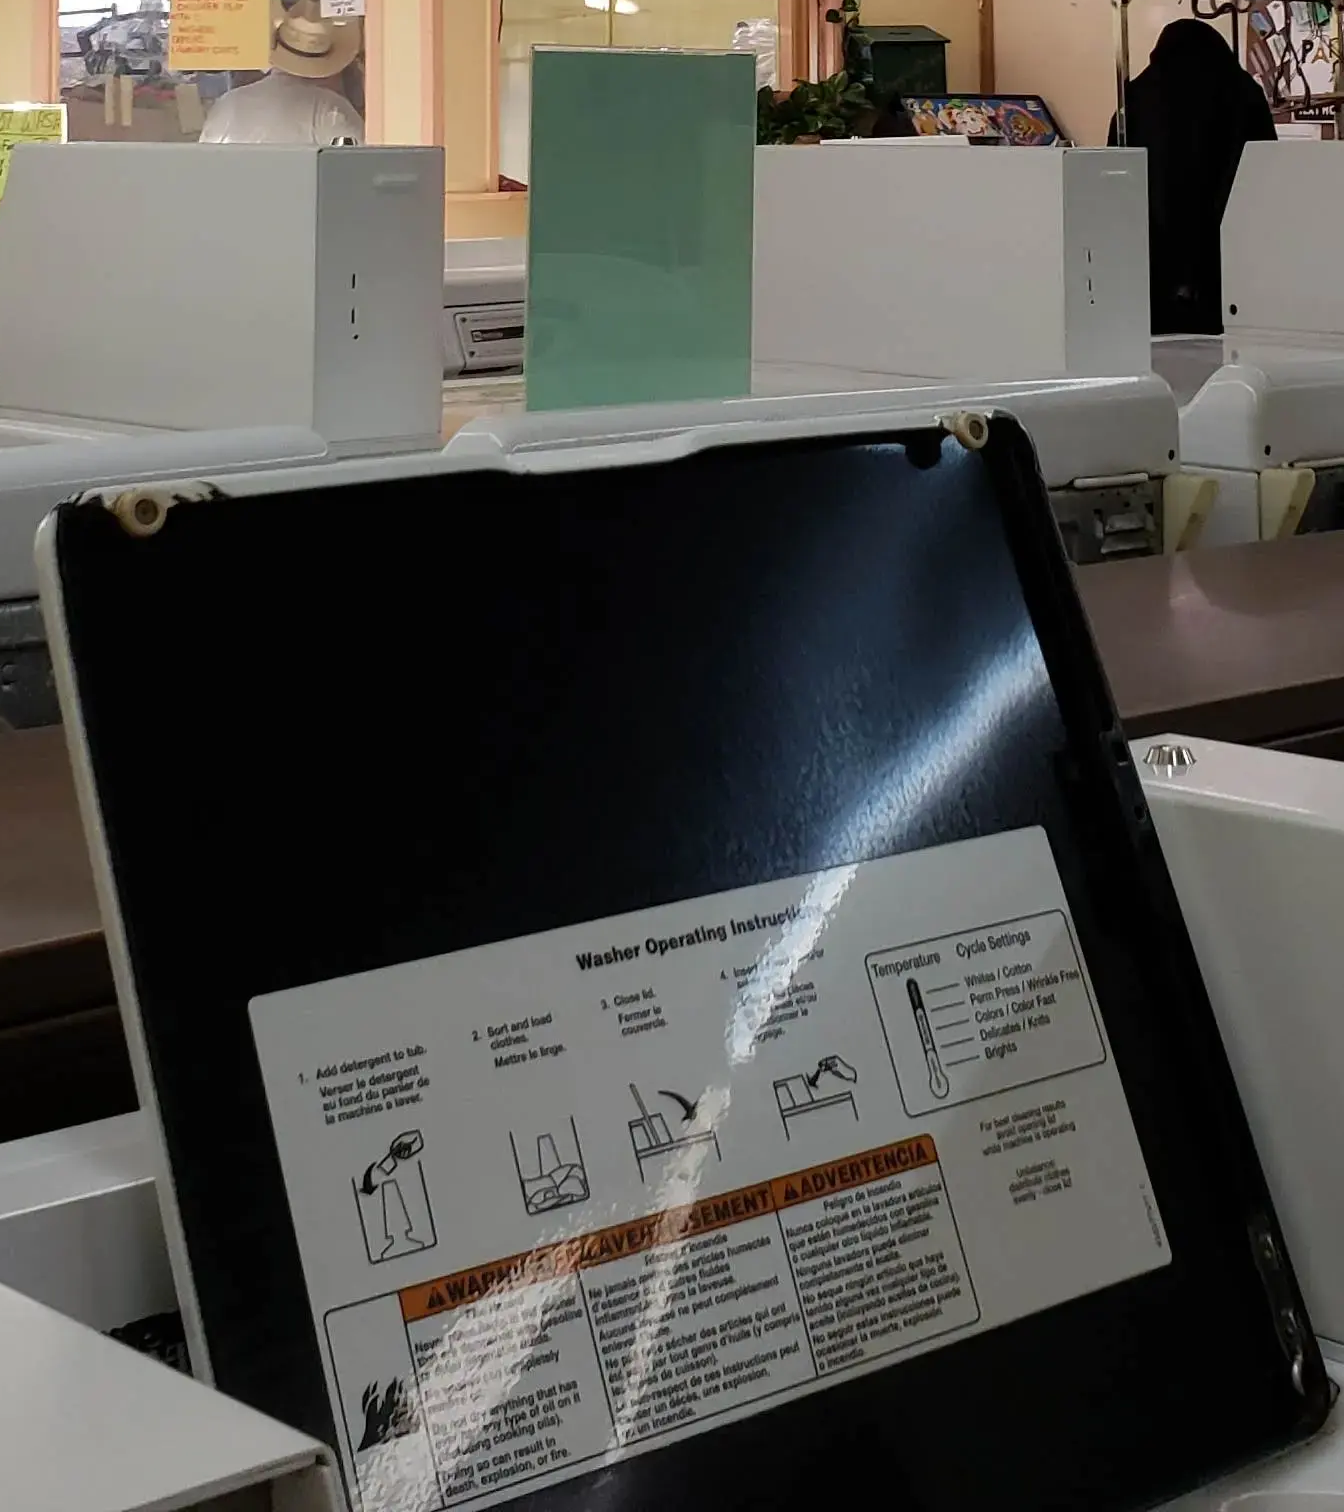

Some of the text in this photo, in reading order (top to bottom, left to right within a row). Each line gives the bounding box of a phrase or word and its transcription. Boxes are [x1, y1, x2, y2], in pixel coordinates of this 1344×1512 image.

[575, 945, 640, 971] Washer
[644, 925, 728, 956] Operating
[870, 930, 1031, 979] Temperature Cycle Settings
[963, 962, 1033, 989] Whites Cotton
[969, 968, 1080, 1007] Perm Press Wrinkle Free
[613, 993, 641, 1007] Close
[641, 987, 656, 1000] lid.
[974, 992, 1057, 1024] Colors Color Fast
[471, 1012, 553, 1043] 2. Sort and load
[617, 1008, 651, 1025] Fermer
[979, 1022, 1022, 1042] Delicates
[489, 1034, 529, 1051] clothes.
[984, 1041, 1018, 1060] Brights
[297, 1044, 427, 1085] 1. Add detergent to tub.
[493, 1052, 528, 1069] Mettre
[318, 1082, 354, 1099] Verser
[355, 1077, 367, 1092] le
[337, 1090, 364, 1109] fond
[364, 1088, 381, 1102] du
[381, 1080, 415, 1099] panier
[416, 1075, 430, 1089] de
[337, 1103, 384, 1123] machine
[797, 1141, 928, 1196] ADVERTENCIA
[722, 1350, 778, 1377] instructions
[488, 1379, 578, 1417] anything that has
[503, 1410, 528, 1428] type
[528, 1404, 541, 1419] of
[556, 1395, 572, 1409] on
[492, 1423, 536, 1446] cooking
[475, 1436, 557, 1473] so can result in
[480, 1460, 536, 1486] explosion,
[536, 1453, 549, 1467] or
[549, 1448, 572, 1462] fire.
